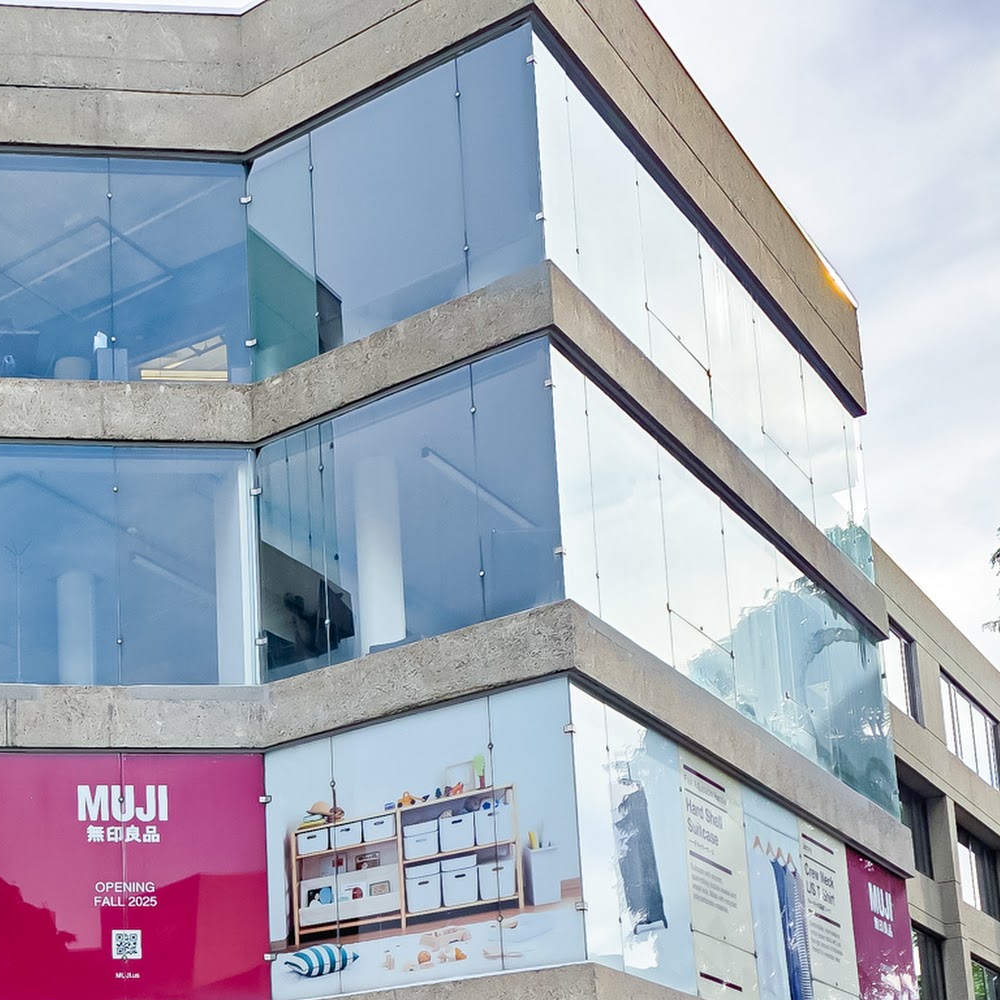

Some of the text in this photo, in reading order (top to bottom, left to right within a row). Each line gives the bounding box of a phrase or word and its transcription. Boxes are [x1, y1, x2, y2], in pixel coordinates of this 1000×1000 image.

[77, 784, 168, 821] MUJI
[686, 797, 723, 830] Hard Shell
[87, 825, 160, 843] 無印良品
[687, 817, 719, 846] Suitcase
[93, 896, 157, 907] FALL 2025
[95, 881, 155, 893] OPENING
[868, 881, 893, 922] MUJI
